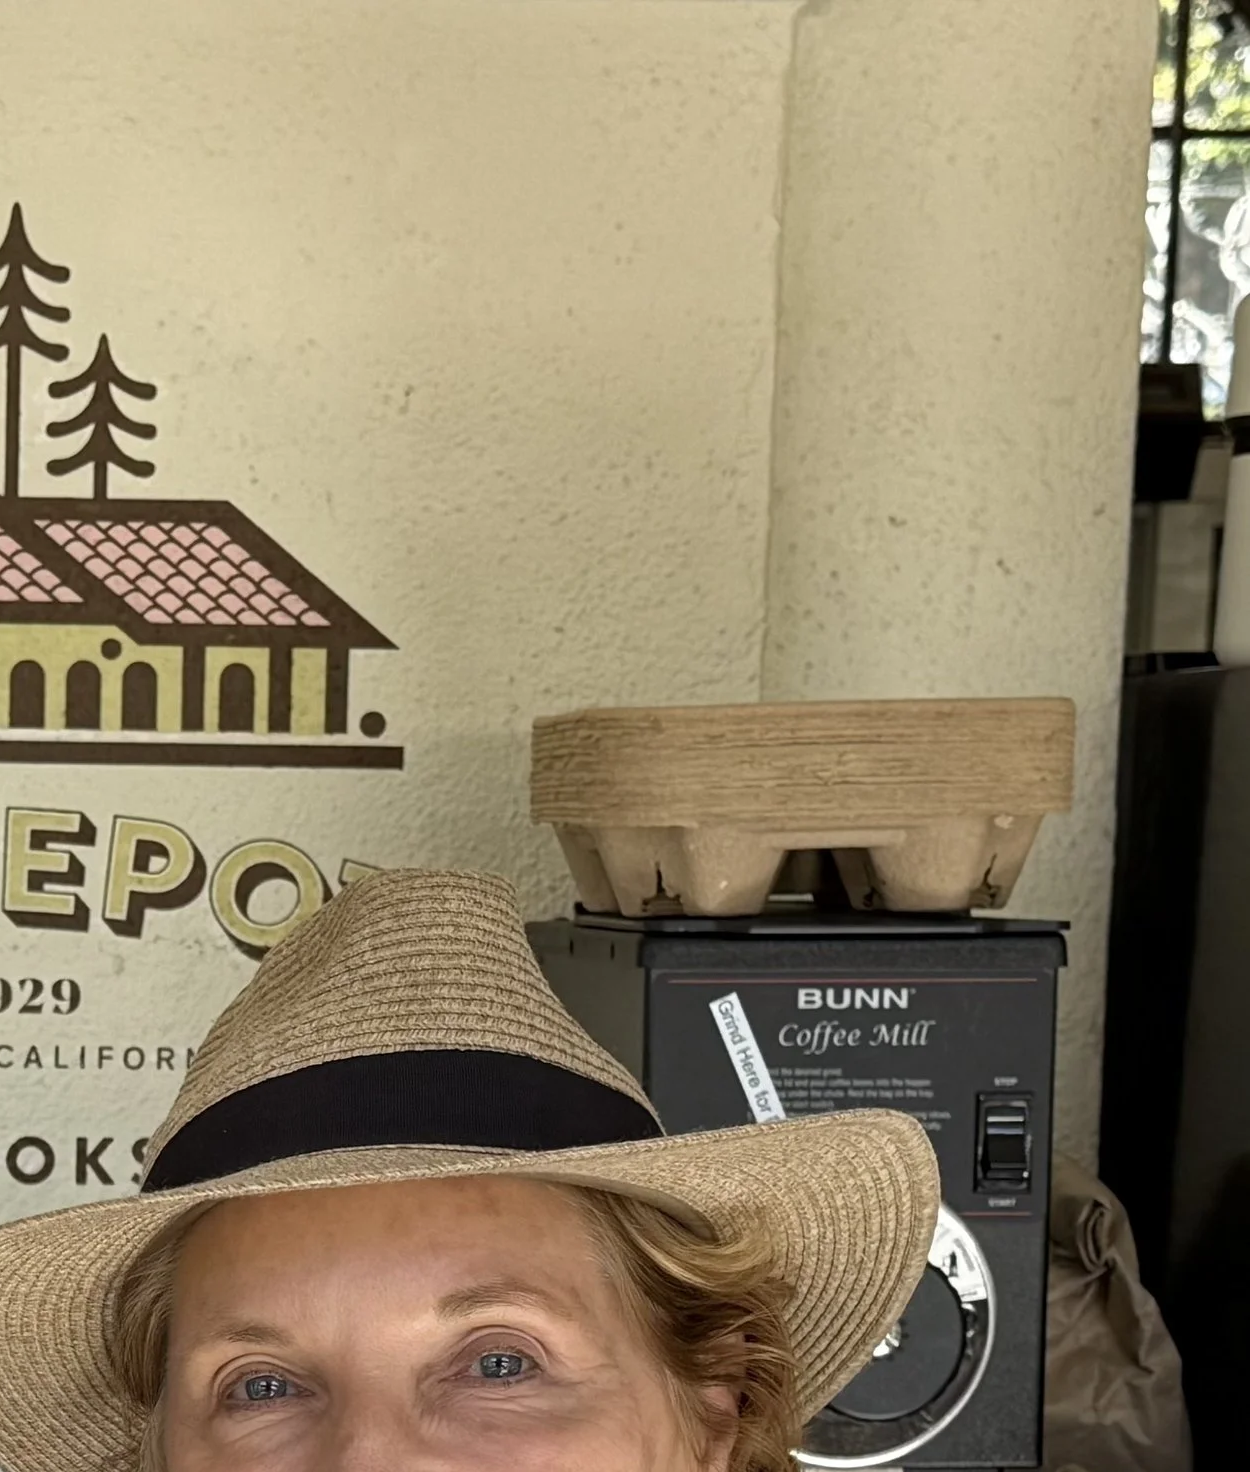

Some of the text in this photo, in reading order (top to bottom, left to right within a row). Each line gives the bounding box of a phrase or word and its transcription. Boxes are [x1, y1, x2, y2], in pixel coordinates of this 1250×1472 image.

[797, 987, 909, 1010] BUNN
[778, 1019, 937, 1056] Coffee Mill
[718, 1000, 772, 1113] Grind Here for
